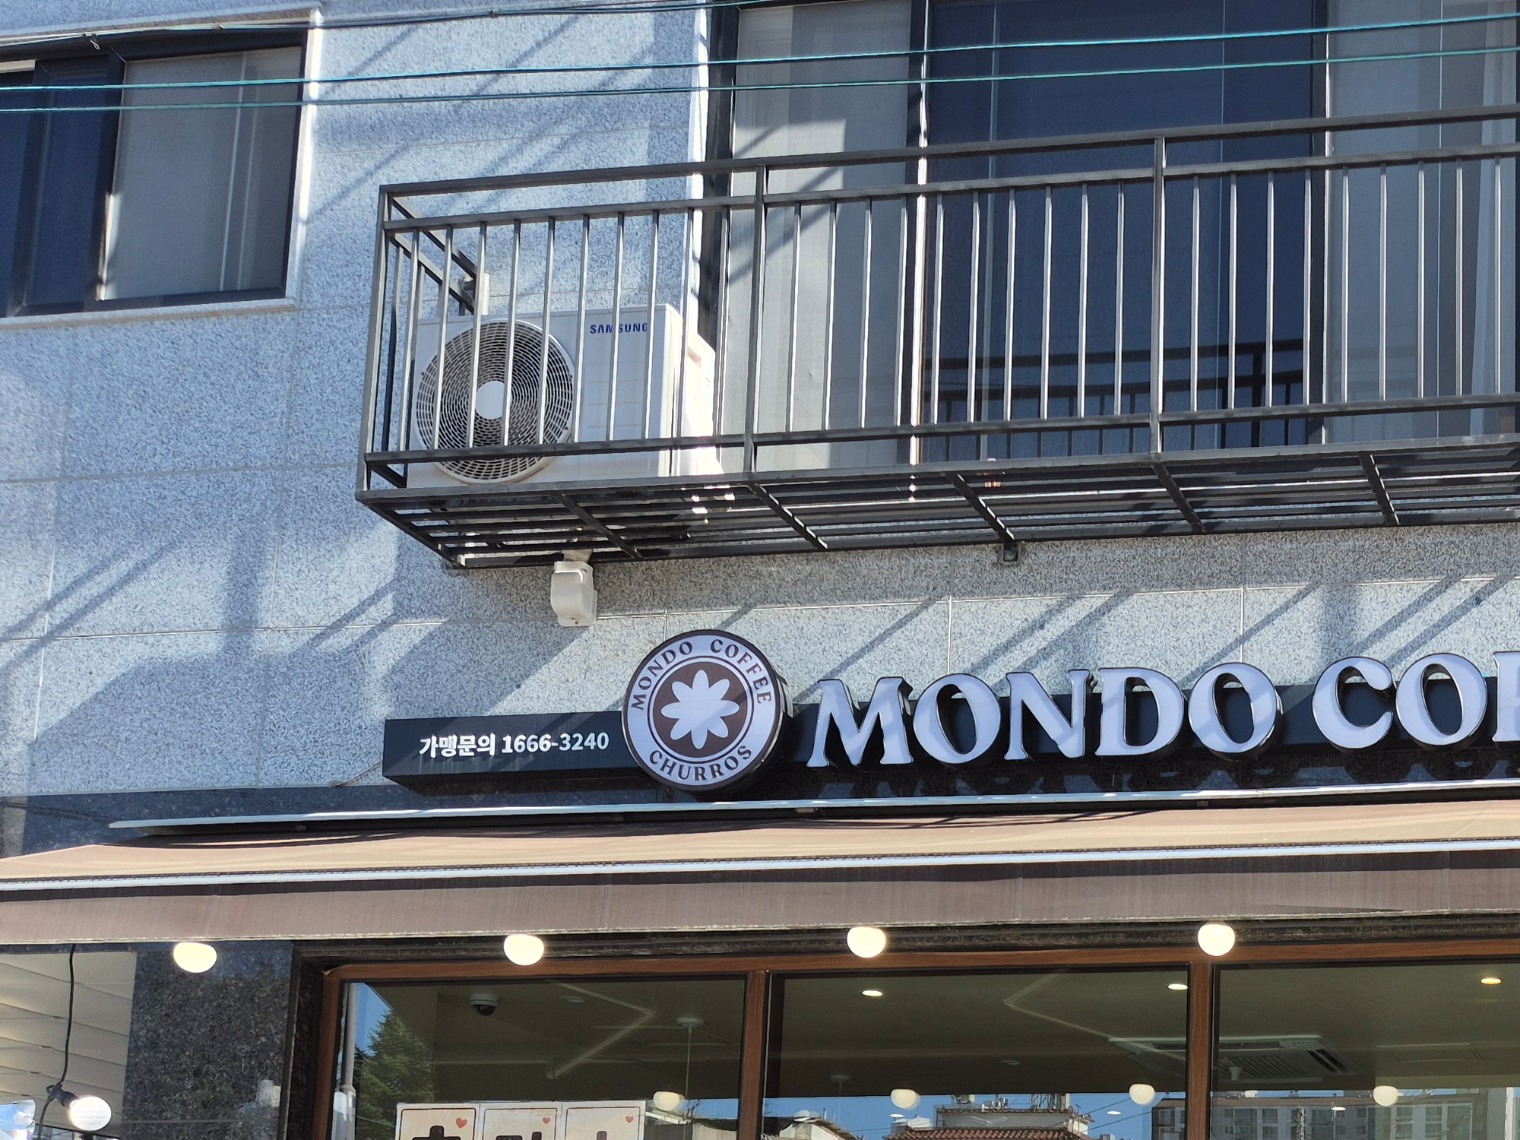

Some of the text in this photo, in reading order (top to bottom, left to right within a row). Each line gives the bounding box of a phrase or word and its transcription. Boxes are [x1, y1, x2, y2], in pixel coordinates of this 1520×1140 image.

[631, 638, 773, 711] MONDO COFFEE
[806, 661, 1280, 769] MONDO
[419, 731, 610, 758] 가맹문의 1666-3240
[648, 744, 754, 783] CHURROS
